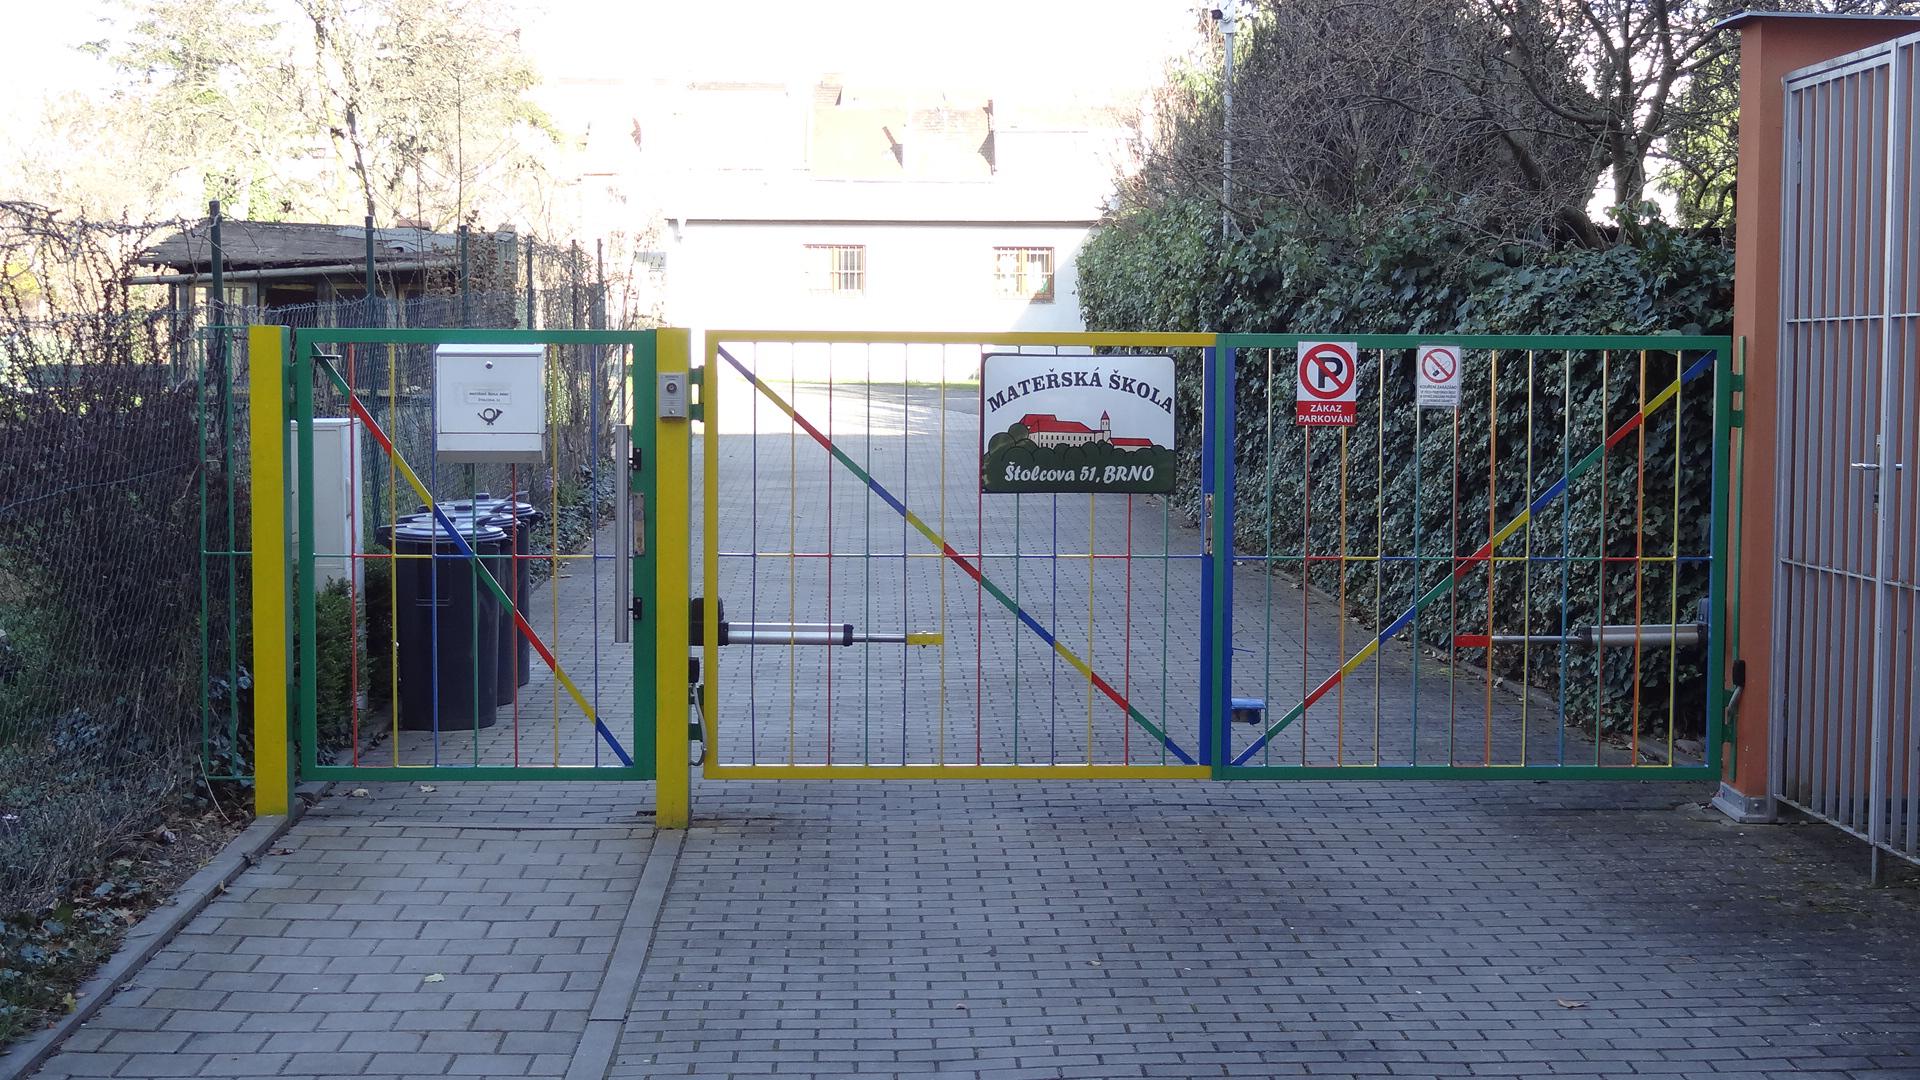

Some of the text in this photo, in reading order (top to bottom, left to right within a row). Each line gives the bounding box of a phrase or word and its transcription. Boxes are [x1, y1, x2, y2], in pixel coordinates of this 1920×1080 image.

[987, 367, 1172, 413] MATEŘSKÁ ŠKOLA
[1310, 403, 1342, 412] ZÁKAZ
[1298, 414, 1353, 423] PARKOVÁNÍ
[1004, 461, 1155, 483] Štolcova 51, BRNO
